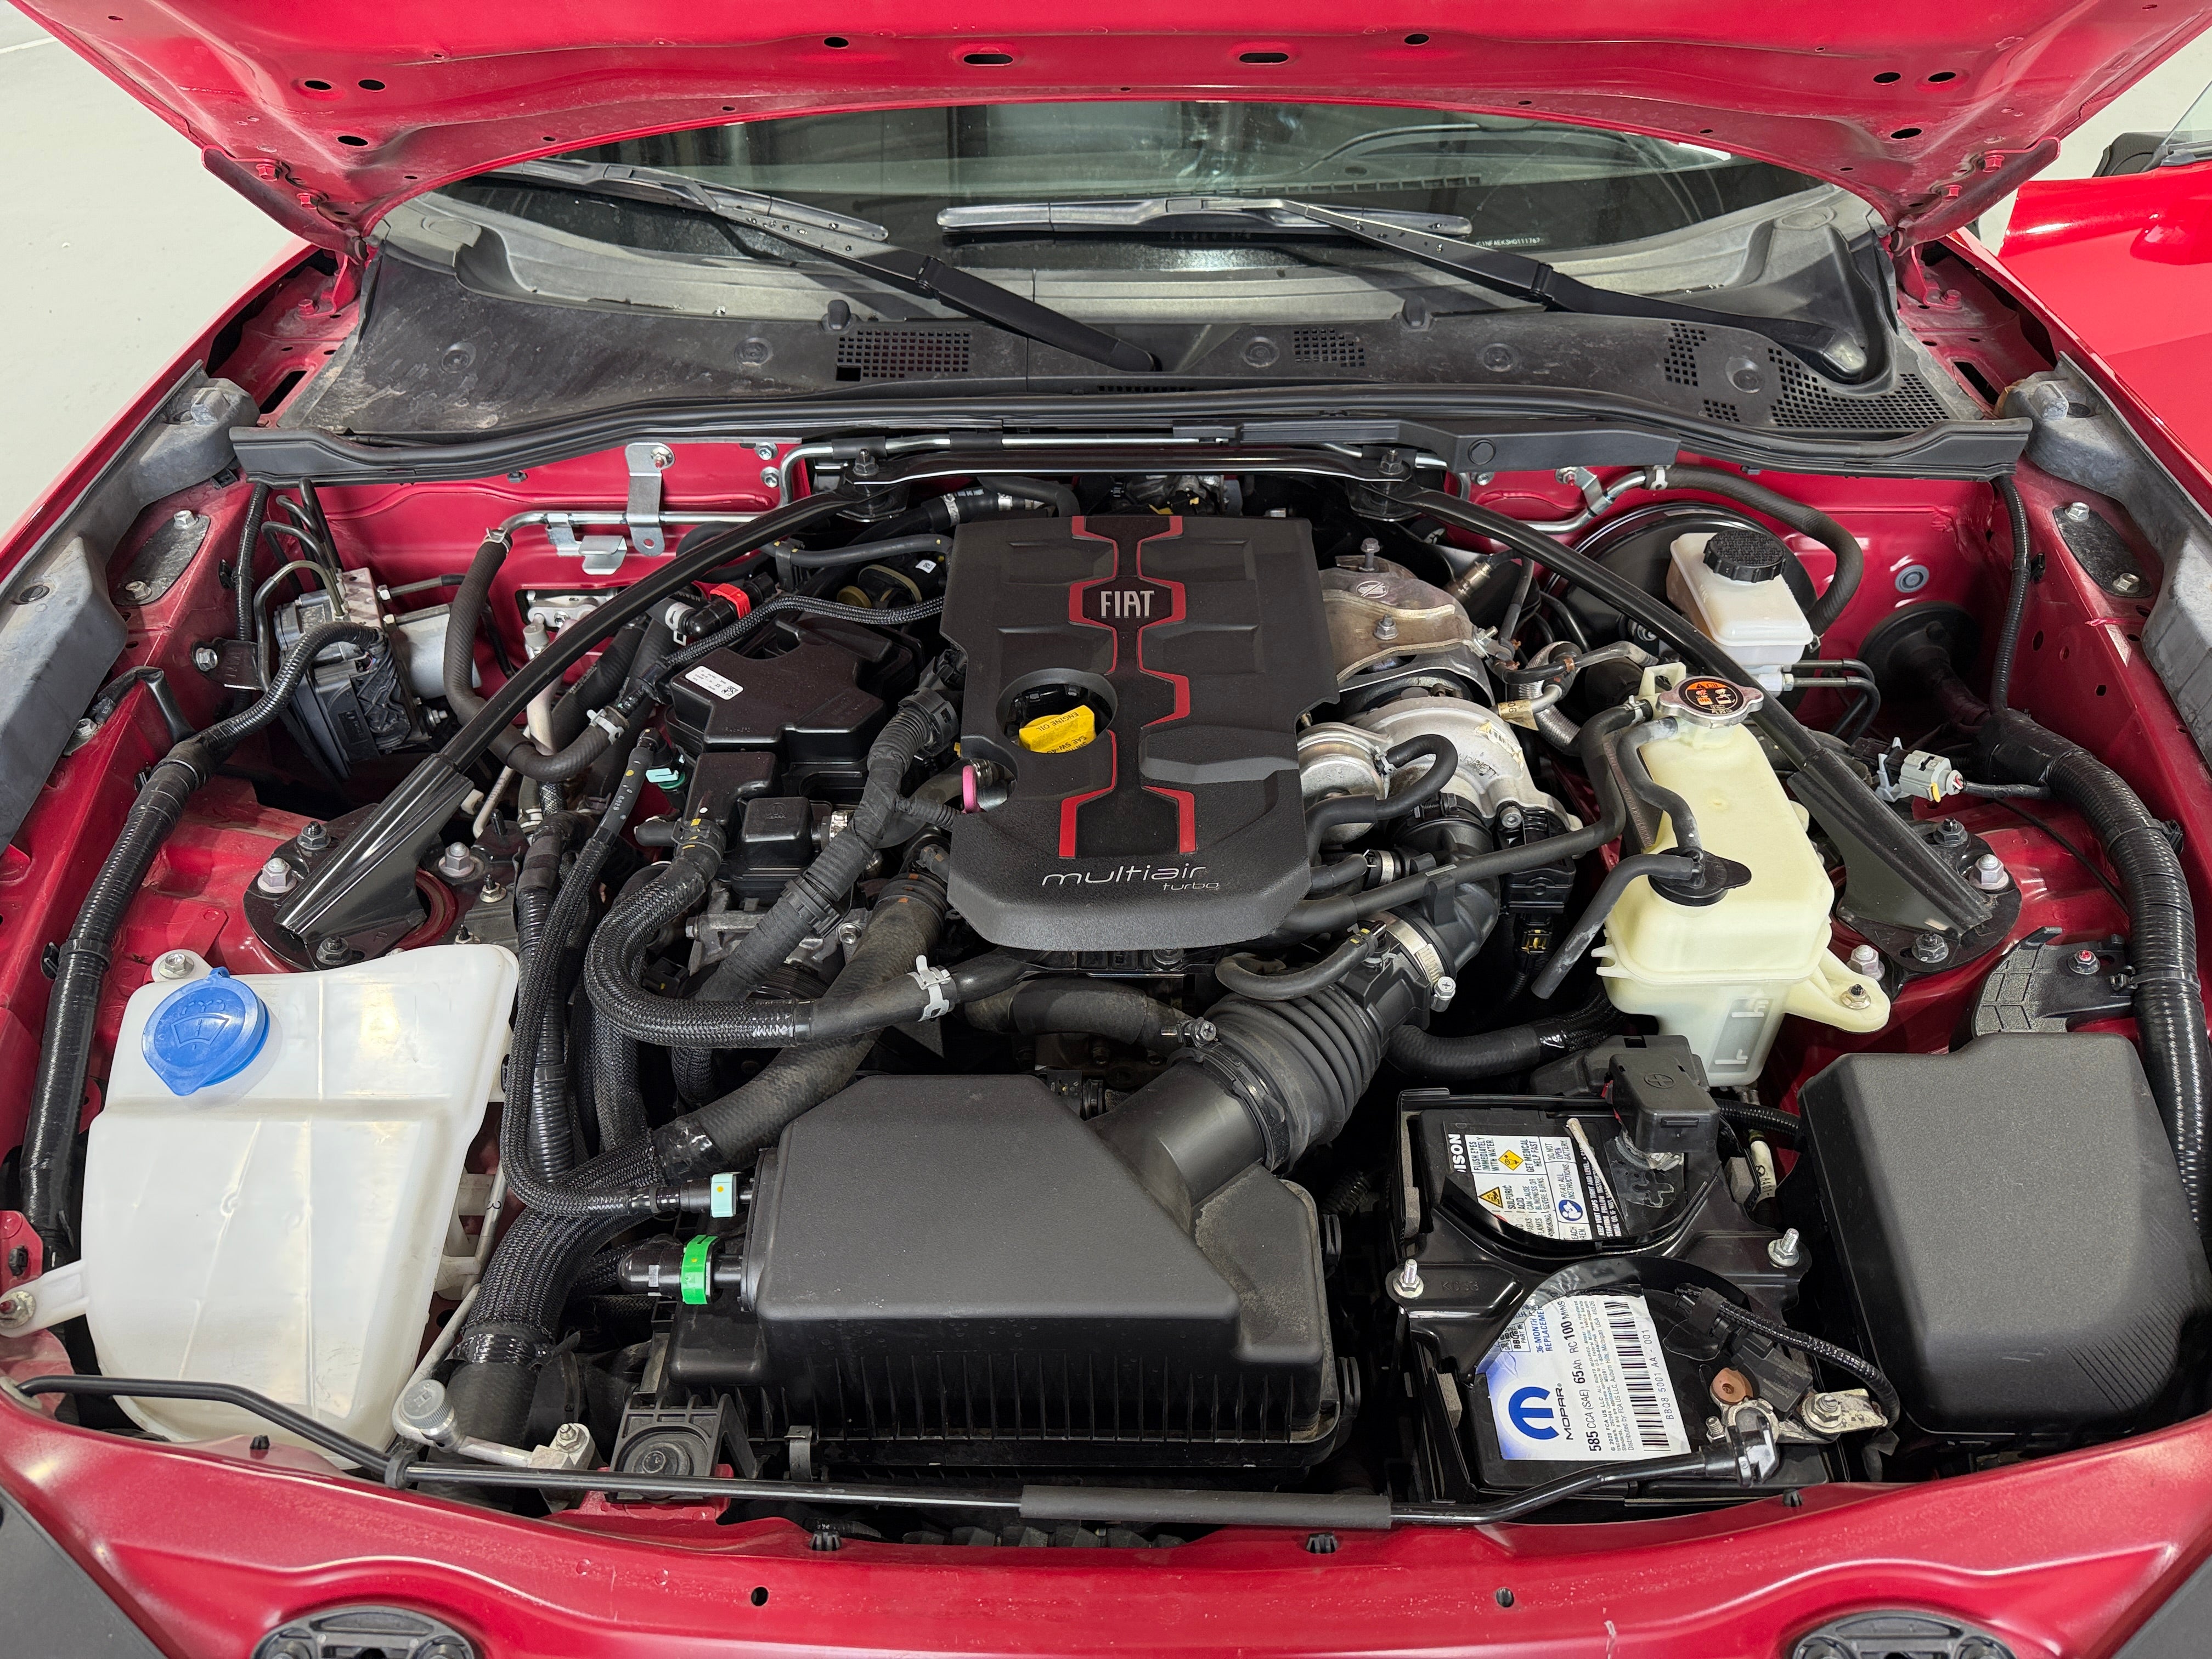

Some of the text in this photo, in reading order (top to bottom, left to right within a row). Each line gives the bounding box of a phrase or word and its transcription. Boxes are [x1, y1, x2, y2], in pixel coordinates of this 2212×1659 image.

[1101, 590, 1155, 618] FIAT
[1036, 712, 1080, 732] ENGINE OIL
[1073, 735, 1087, 745] SAE
[1042, 863, 1206, 886] multiair
[1163, 882, 1220, 891] turbo
[1448, 1133, 1467, 1173] ISON
[1469, 1142, 1482, 1171] FLUSH EYES
[1476, 1136, 1491, 1171] IMMEDIATELY
[1486, 1138, 1500, 1171] WITH WATER.
[1520, 1139, 1534, 1173] GET MEDICAL
[1531, 1141, 1543, 1167] HELP FAST
[1545, 1143, 1555, 1160] DO NOT
[1554, 1147, 1564, 1159] OPEN
[1560, 1139, 1572, 1161] BATTERY.
[1556, 1173, 1567, 1199] READ ALL
[1562, 1163, 1577, 1200] INSTRUCTIONS.
[1585, 1176, 1594, 1186] AND
[1502, 1185, 1516, 1210] SULFURIC
[1522, 1185, 1534, 1210] CAN CAUSE
[1529, 1178, 1543, 1210] BLINDNESS OR
[1536, 1176, 1550, 1210] SEVERE BURNS.
[1588, 1186, 1597, 1199] TIGHT
[1516, 1197, 1526, 1210] ACID
[1591, 1199, 1600, 1212] CAPS
[1598, 1195, 1608, 1214] FOLLOW
[1594, 1212, 1602, 1224] VENT
[1602, 1215, 1613, 1237] STARTING
[1611, 1215, 1618, 1223] OR
[1557, 1301, 1569, 1321] MINS
[1530, 1318, 1544, 1353] 36-MONTH
[1561, 1321, 1575, 1341] 100
[1598, 1330, 1607, 1351] Michigan
[1641, 1330, 1652, 1345] 001
[1568, 1341, 1579, 1353] RC
[1649, 1357, 1659, 1368] AA
[1607, 1365, 1616, 1382] Auburn
[1654, 1373, 1667, 1392] 5001
[414, 1390, 432, 1408] H
[1579, 1389, 1594, 1410] (SAE)
[1661, 1397, 1674, 1420] BBQ8
[1584, 1412, 1596, 1429] CCA
[1601, 1409, 1607, 1418] US
[1585, 1431, 1602, 1452] 585
[1622, 1423, 1634, 1451] Distributed
